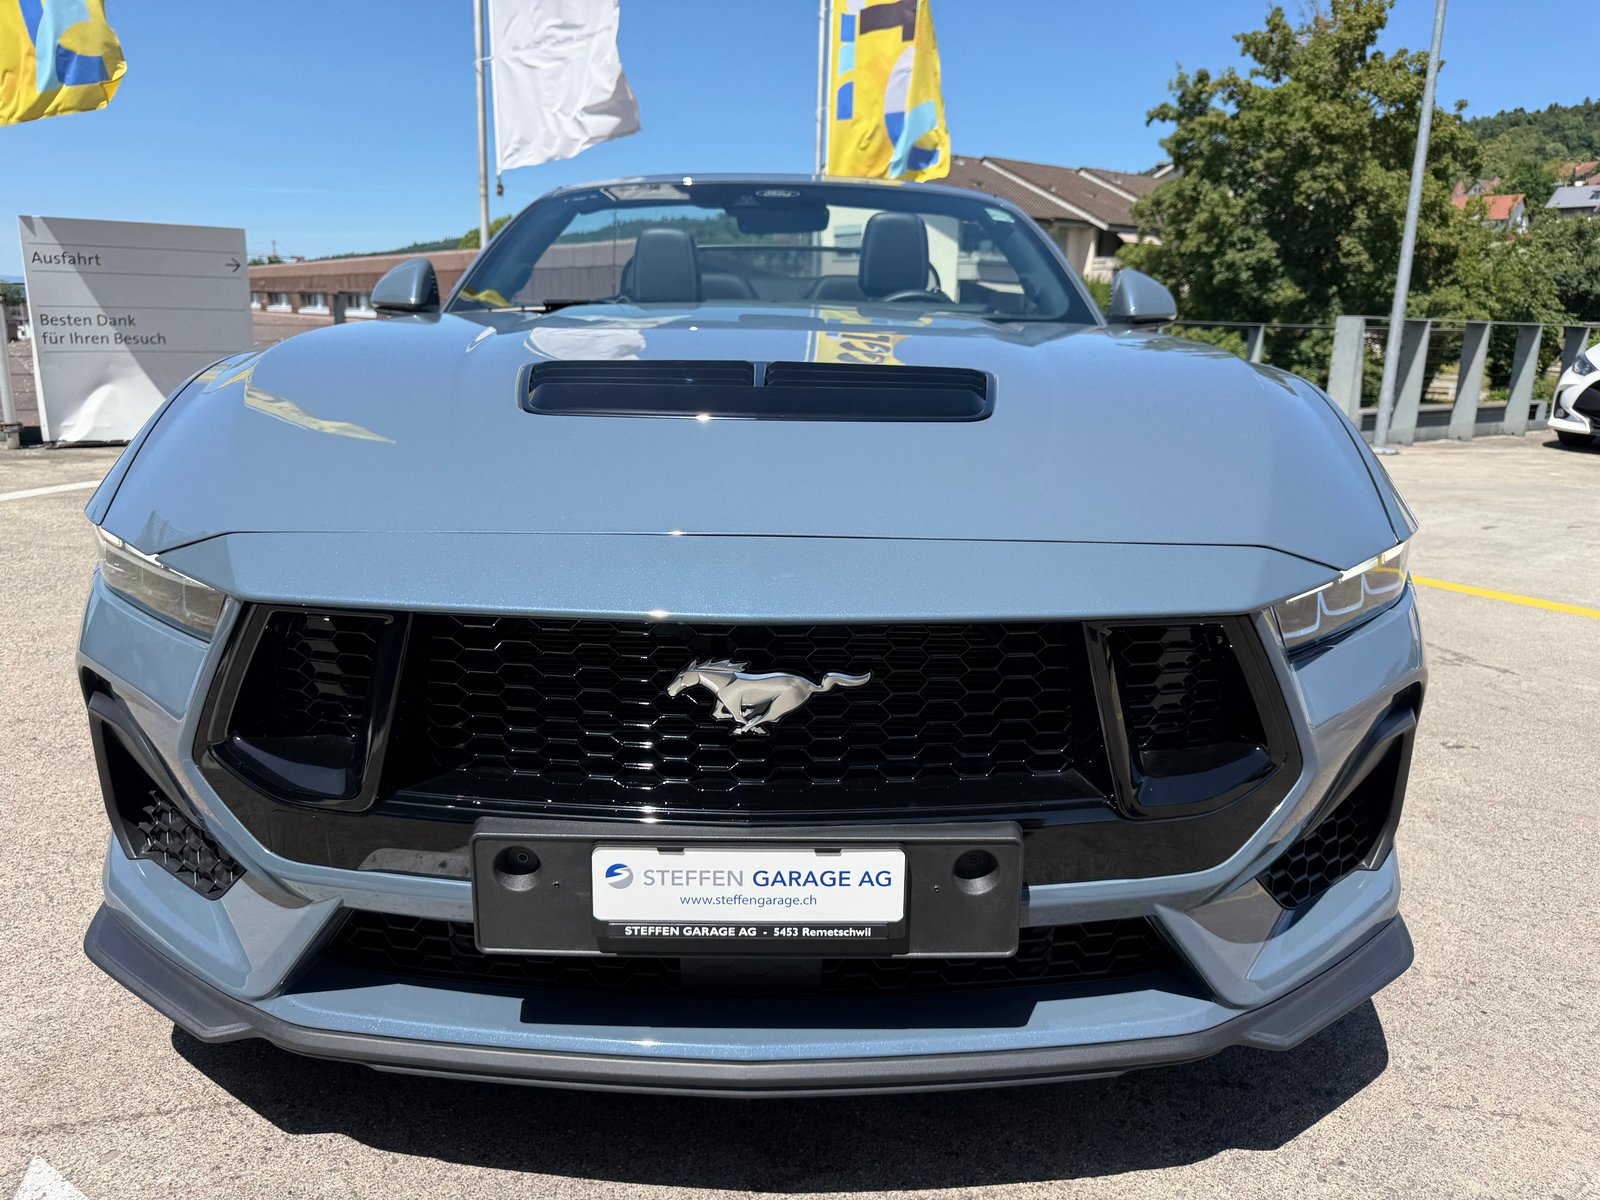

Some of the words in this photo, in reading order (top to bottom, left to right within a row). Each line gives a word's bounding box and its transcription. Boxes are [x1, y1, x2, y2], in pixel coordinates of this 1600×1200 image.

[31, 251, 102, 266] Ausfahrt
[40, 313, 92, 327] Besten
[97, 314, 137, 328] Dank
[42, 332, 64, 345] für
[70, 332, 109, 345] Ihren
[114, 332, 167, 346] Besuch
[643, 869, 743, 887] STEFFEN
[752, 869, 851, 888] GARAGE
[858, 870, 892, 887] AG
[680, 894, 817, 908] www.steffengarage.ch
[624, 925, 680, 937] STEFFEN
[682, 925, 735, 937] GARAGE
[738, 926, 757, 937] AG
[773, 926, 799, 938] 5453
[802, 926, 872, 938] Remetschwil
